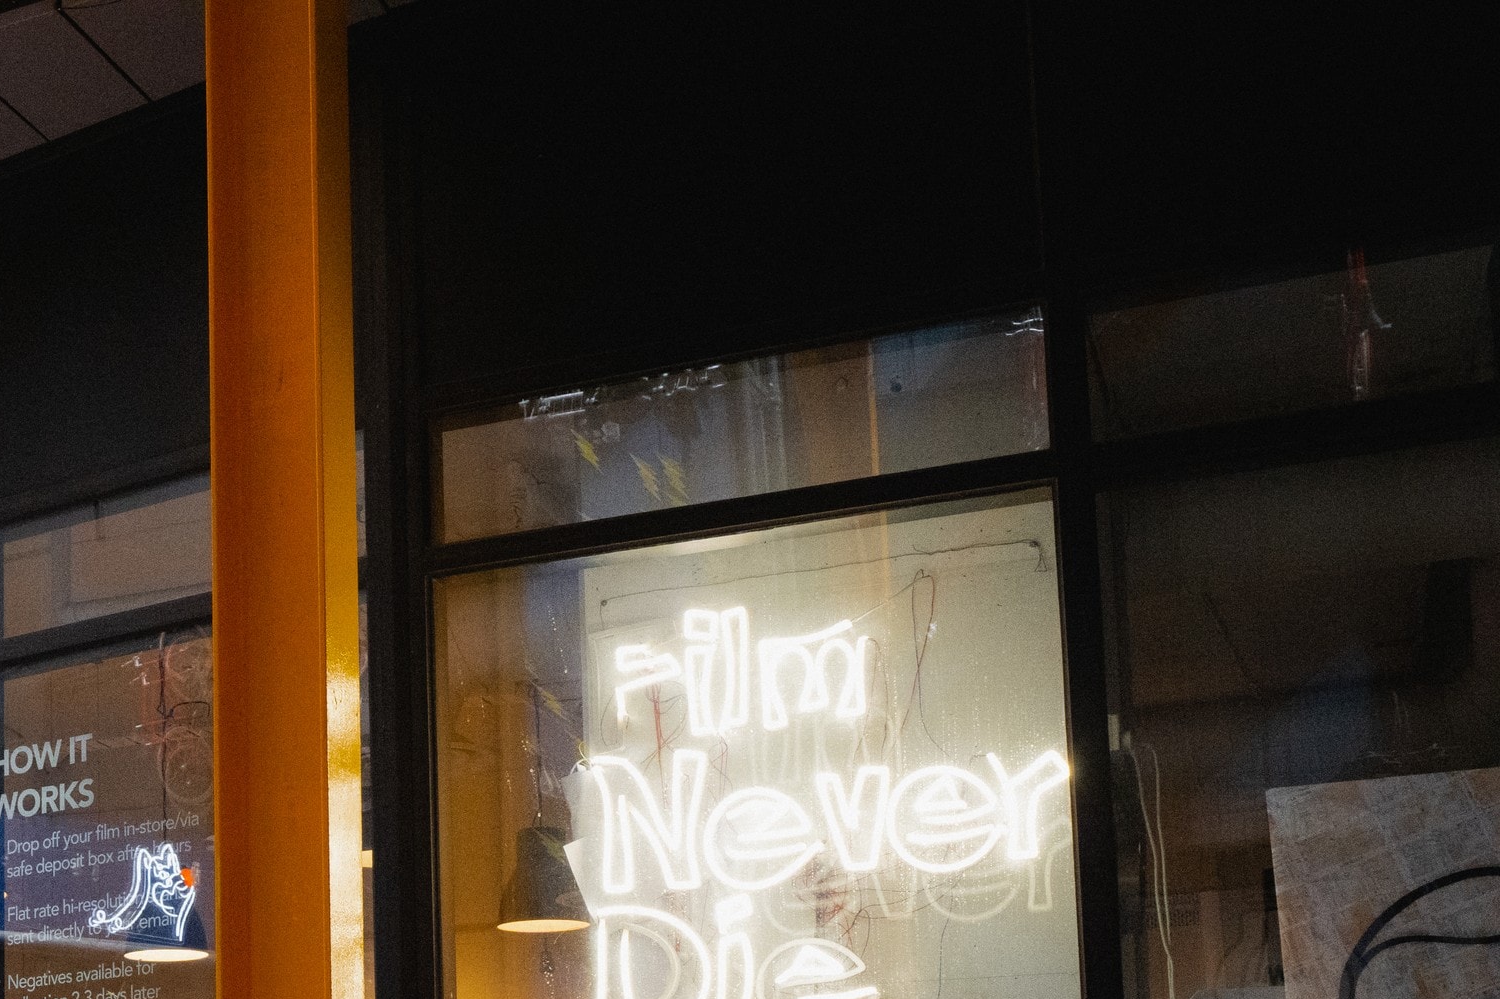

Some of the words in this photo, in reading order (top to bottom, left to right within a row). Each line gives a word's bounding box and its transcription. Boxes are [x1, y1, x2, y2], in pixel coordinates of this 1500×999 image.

[614, 606, 870, 737] Film
[69, 733, 93, 764] IT
[7, 840, 39, 857] Drop
[43, 831, 60, 848] off
[63, 829, 92, 850] your
[95, 824, 120, 841] film
[124, 813, 200, 837] in-store/via
[590, 746, 1071, 895] Never
[7, 862, 32, 878] safe
[36, 855, 84, 877] deposit
[88, 850, 114, 866] box
[118, 844, 149, 862] aft
[152, 840, 192, 856] hurs
[7, 905, 31, 922] Flat
[34, 904, 60, 918] rate
[7, 930, 34, 946] sent
[37, 921, 85, 942] directly
[8, 970, 72, 992] Negatives
[76, 960, 133, 983] available
[136, 959, 156, 976] for
